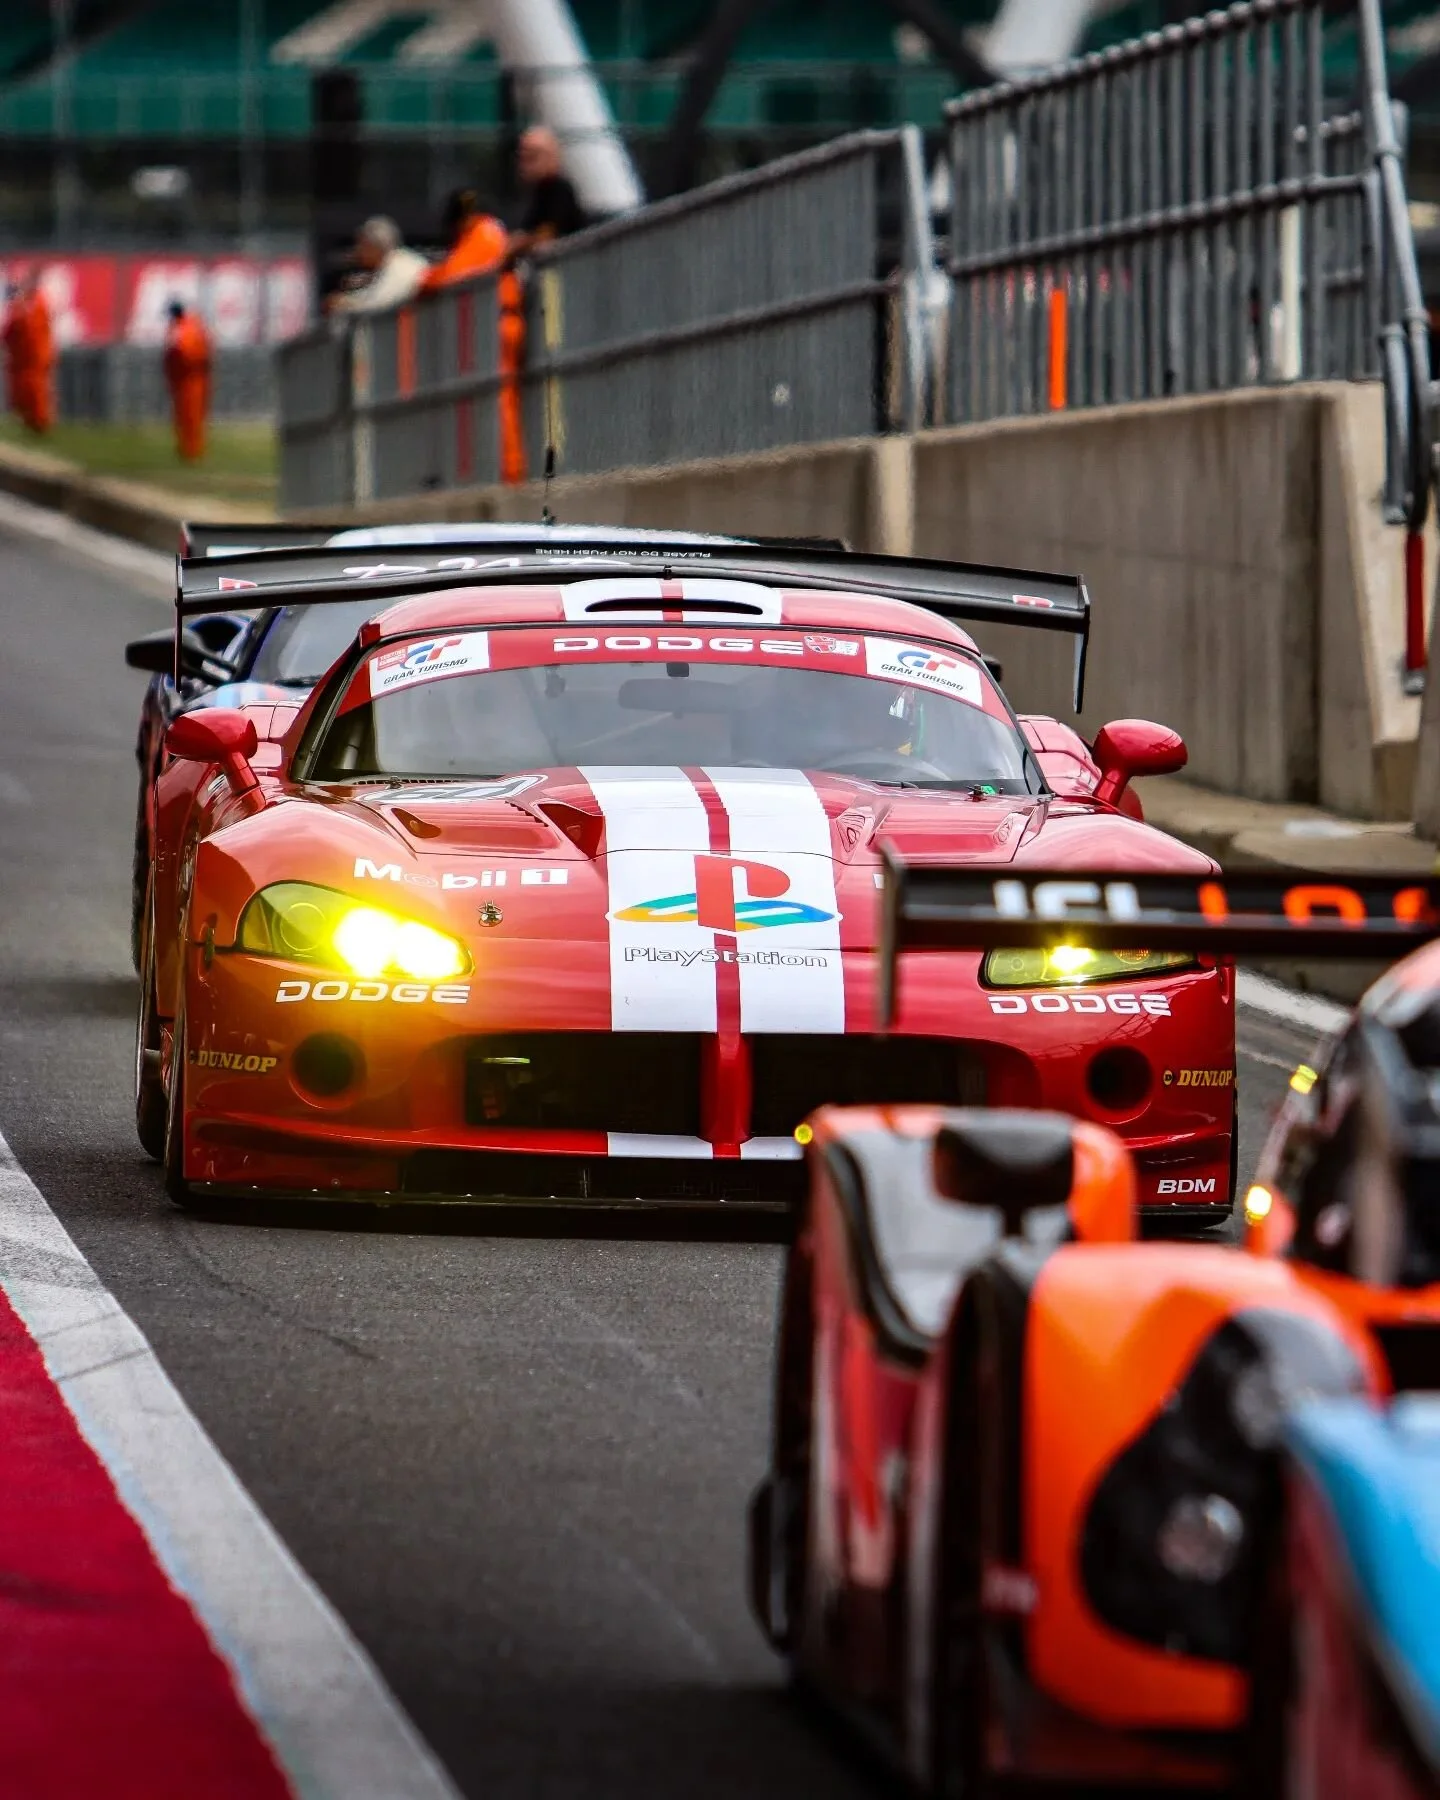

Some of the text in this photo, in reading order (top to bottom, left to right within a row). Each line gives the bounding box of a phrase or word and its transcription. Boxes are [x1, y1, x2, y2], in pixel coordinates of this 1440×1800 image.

[553, 636, 804, 655] DODGE
[383, 669, 415, 685] GRAN
[418, 657, 469, 673] TURISMO
[880, 663, 964, 691] GRAN TURISMO
[353, 857, 507, 890] Mobil
[624, 946, 828, 967] PlayStation
[275, 981, 471, 1004] DODGE
[987, 993, 1172, 1016] DODGE
[197, 1050, 278, 1073] DUNLOP
[1176, 1069, 1233, 1087] DUNLOP
[1156, 1178, 1216, 1194] BDM
